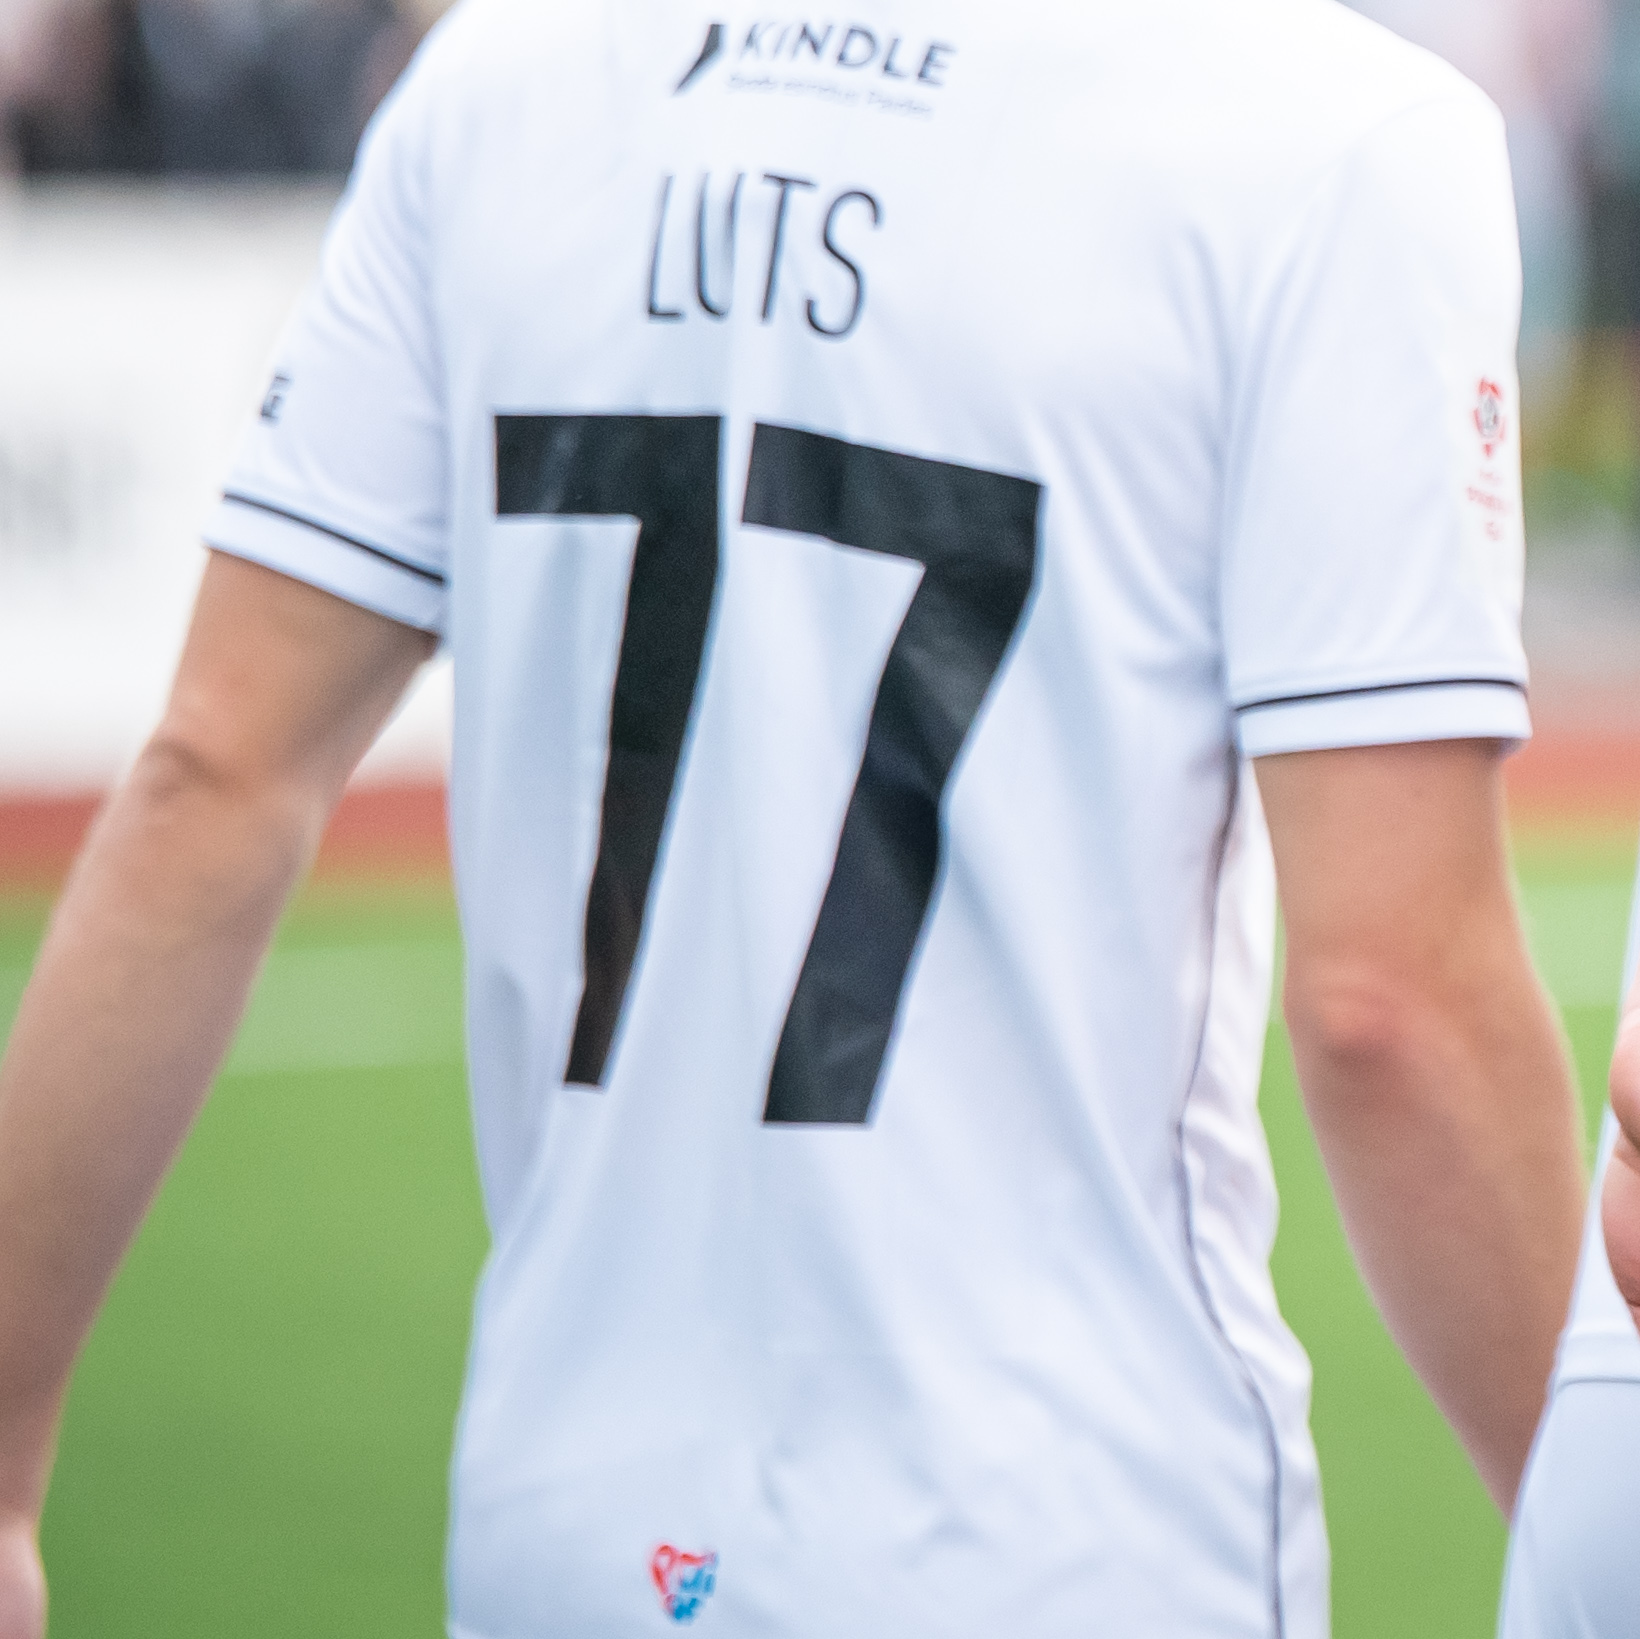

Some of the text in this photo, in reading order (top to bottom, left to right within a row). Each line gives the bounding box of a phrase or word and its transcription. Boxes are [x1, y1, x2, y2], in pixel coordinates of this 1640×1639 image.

[738, 21, 955, 87] KINDLE
[644, 172, 883, 340] LUTS
[493, 413, 1045, 1128] 77
